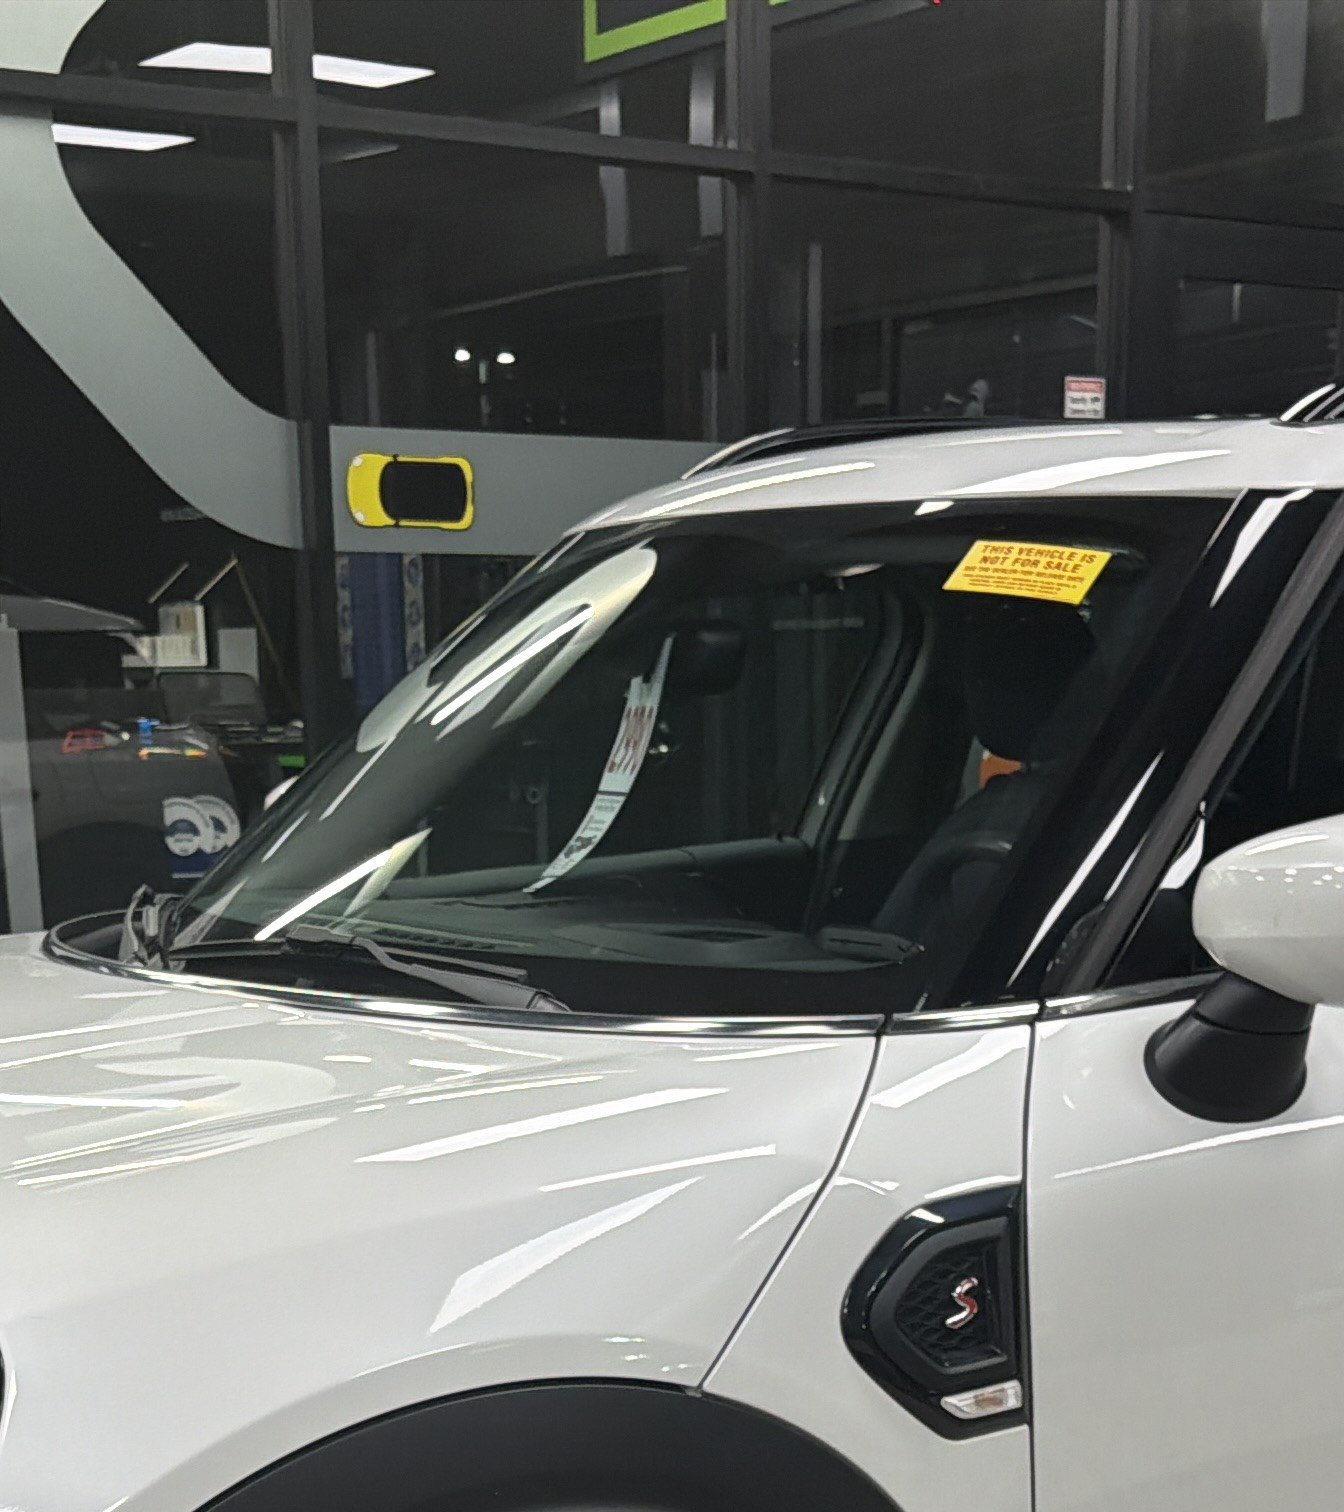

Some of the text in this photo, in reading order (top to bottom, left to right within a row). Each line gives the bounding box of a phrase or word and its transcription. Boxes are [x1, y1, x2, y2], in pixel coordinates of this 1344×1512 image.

[982, 544, 1097, 564] THIS VEHICLE IS
[979, 555, 1083, 574] NOT FOR SALE
[945, 1276, 979, 1330] S
